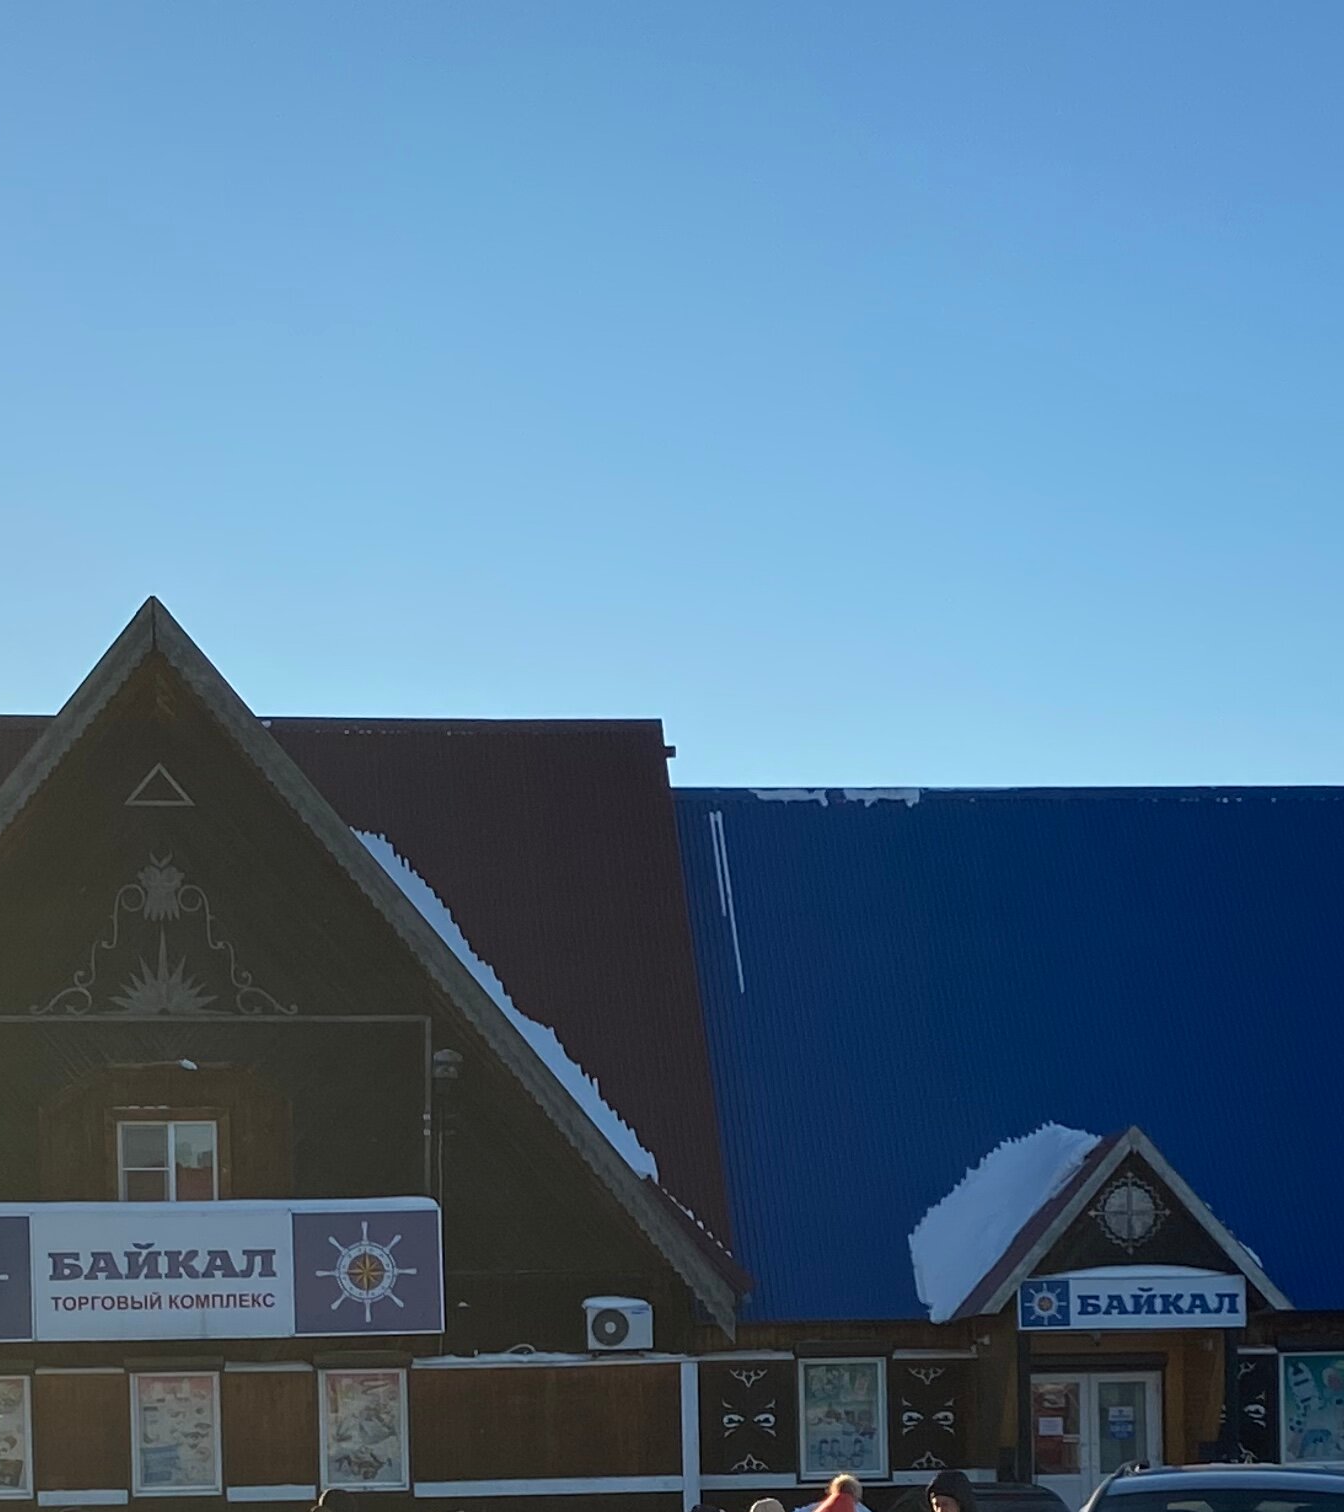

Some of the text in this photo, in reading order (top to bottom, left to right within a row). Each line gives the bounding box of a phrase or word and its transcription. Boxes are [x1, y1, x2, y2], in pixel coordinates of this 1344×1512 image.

[48, 1242, 277, 1281] БАЙКАЛ
[51, 1292, 276, 1312] ТОРГОВЫЙ КОМПЛЕКС
[1076, 1287, 1240, 1316] БАЙКАЛ
